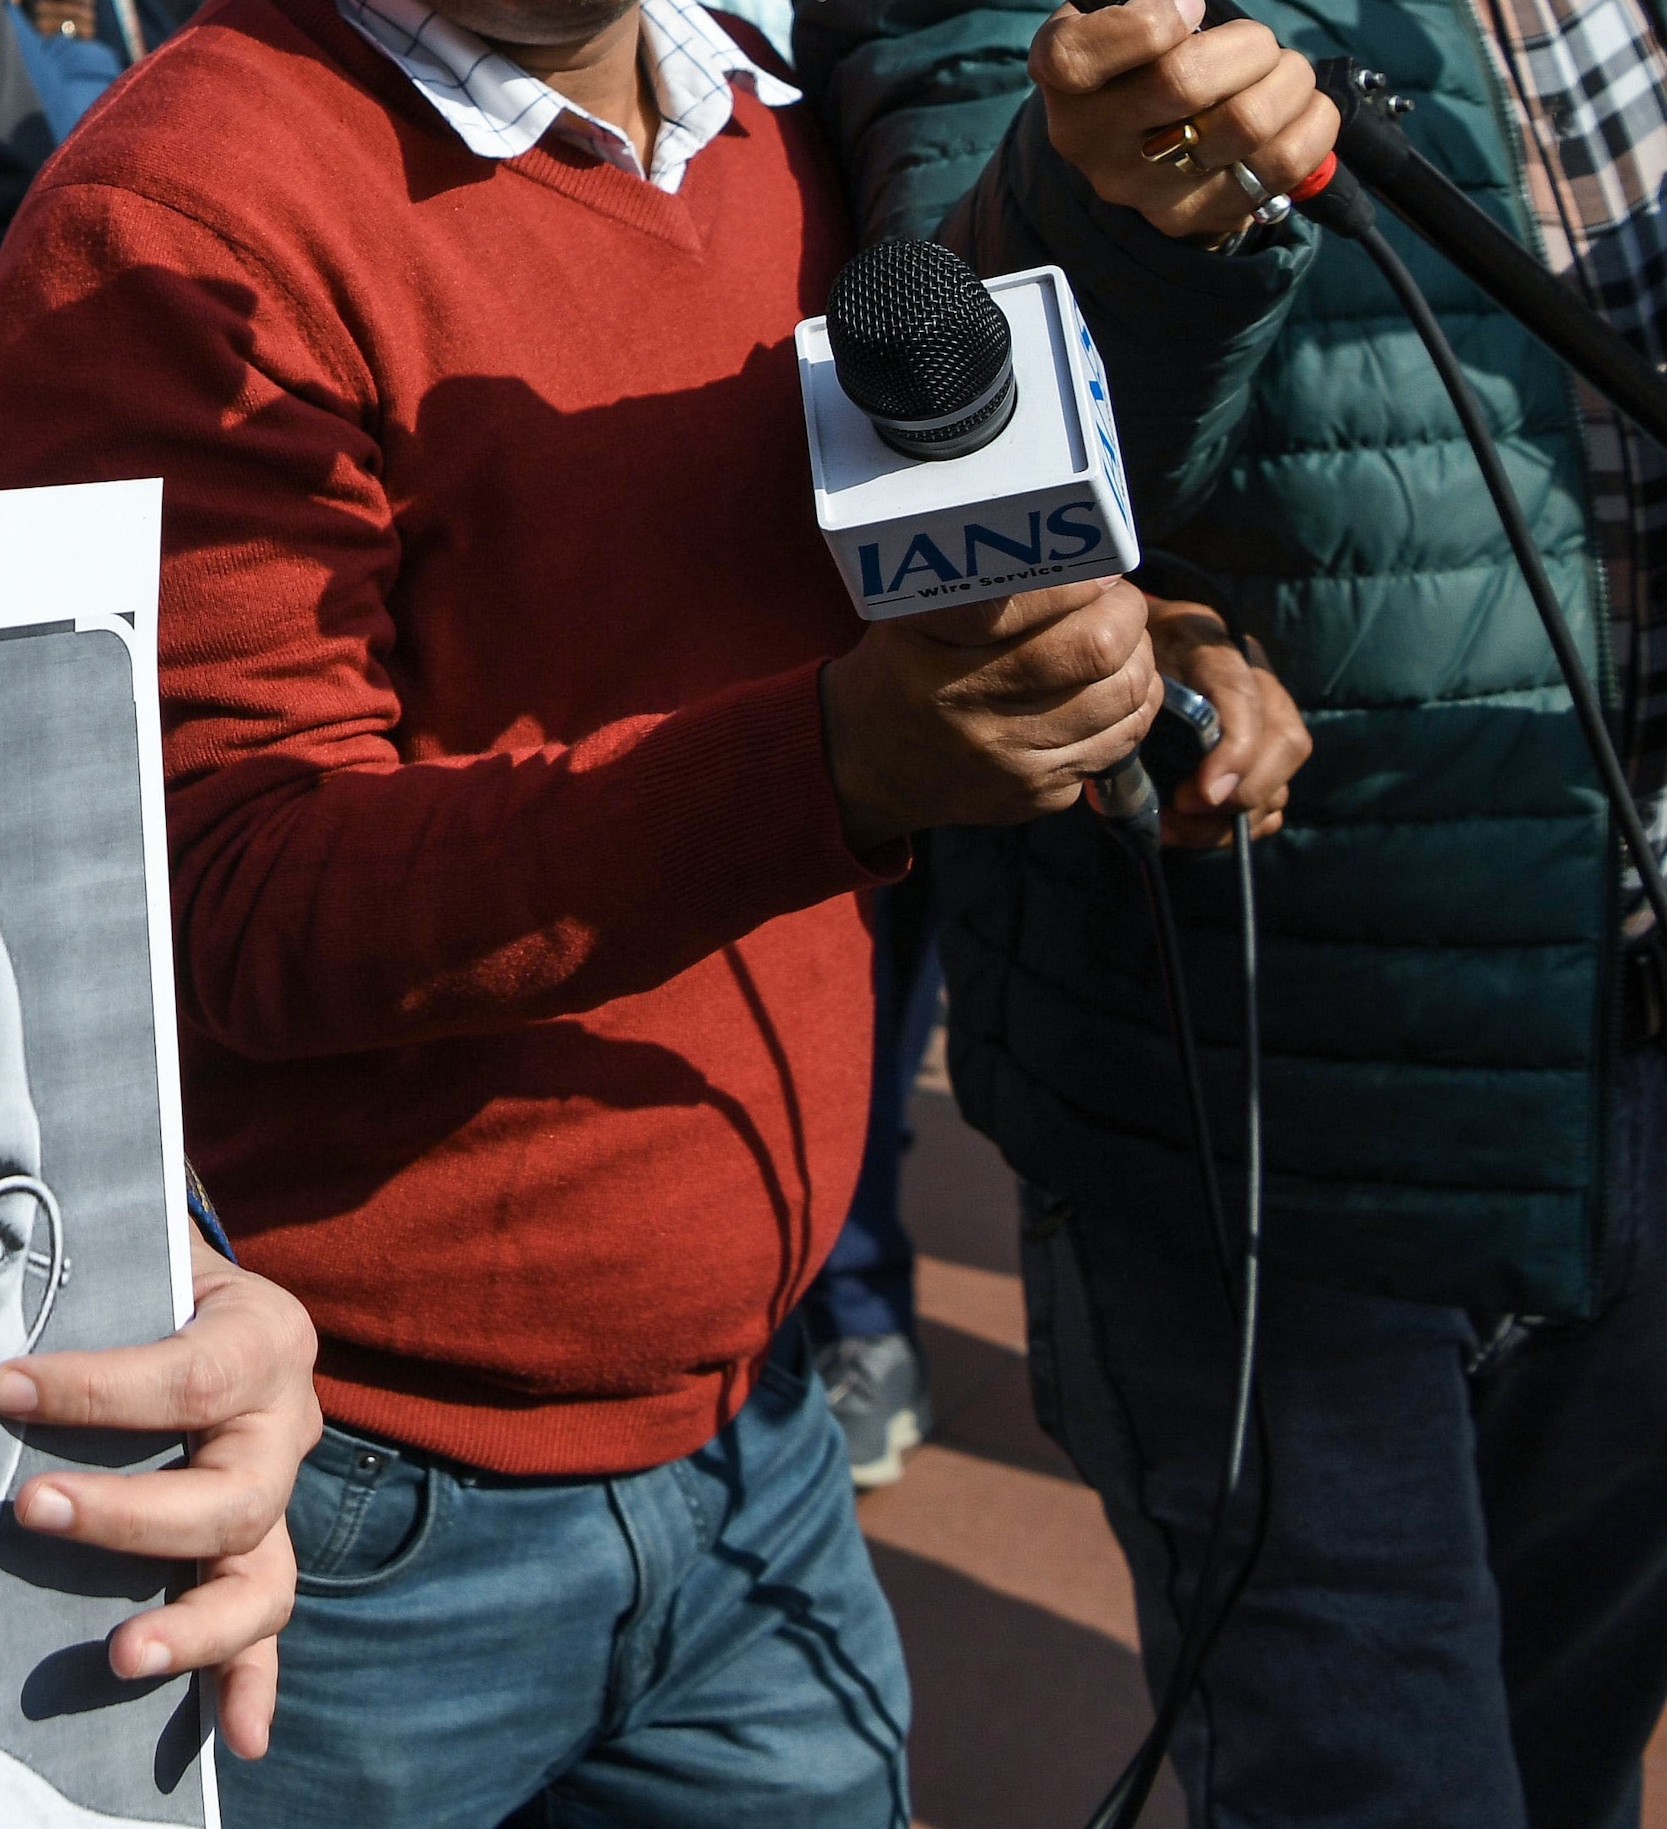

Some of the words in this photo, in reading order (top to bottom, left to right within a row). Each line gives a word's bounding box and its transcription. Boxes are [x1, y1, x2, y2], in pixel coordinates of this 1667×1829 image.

[858, 500, 1102, 597] IANS
[917, 581, 972, 598] Wire
[979, 564, 1064, 587] Service
